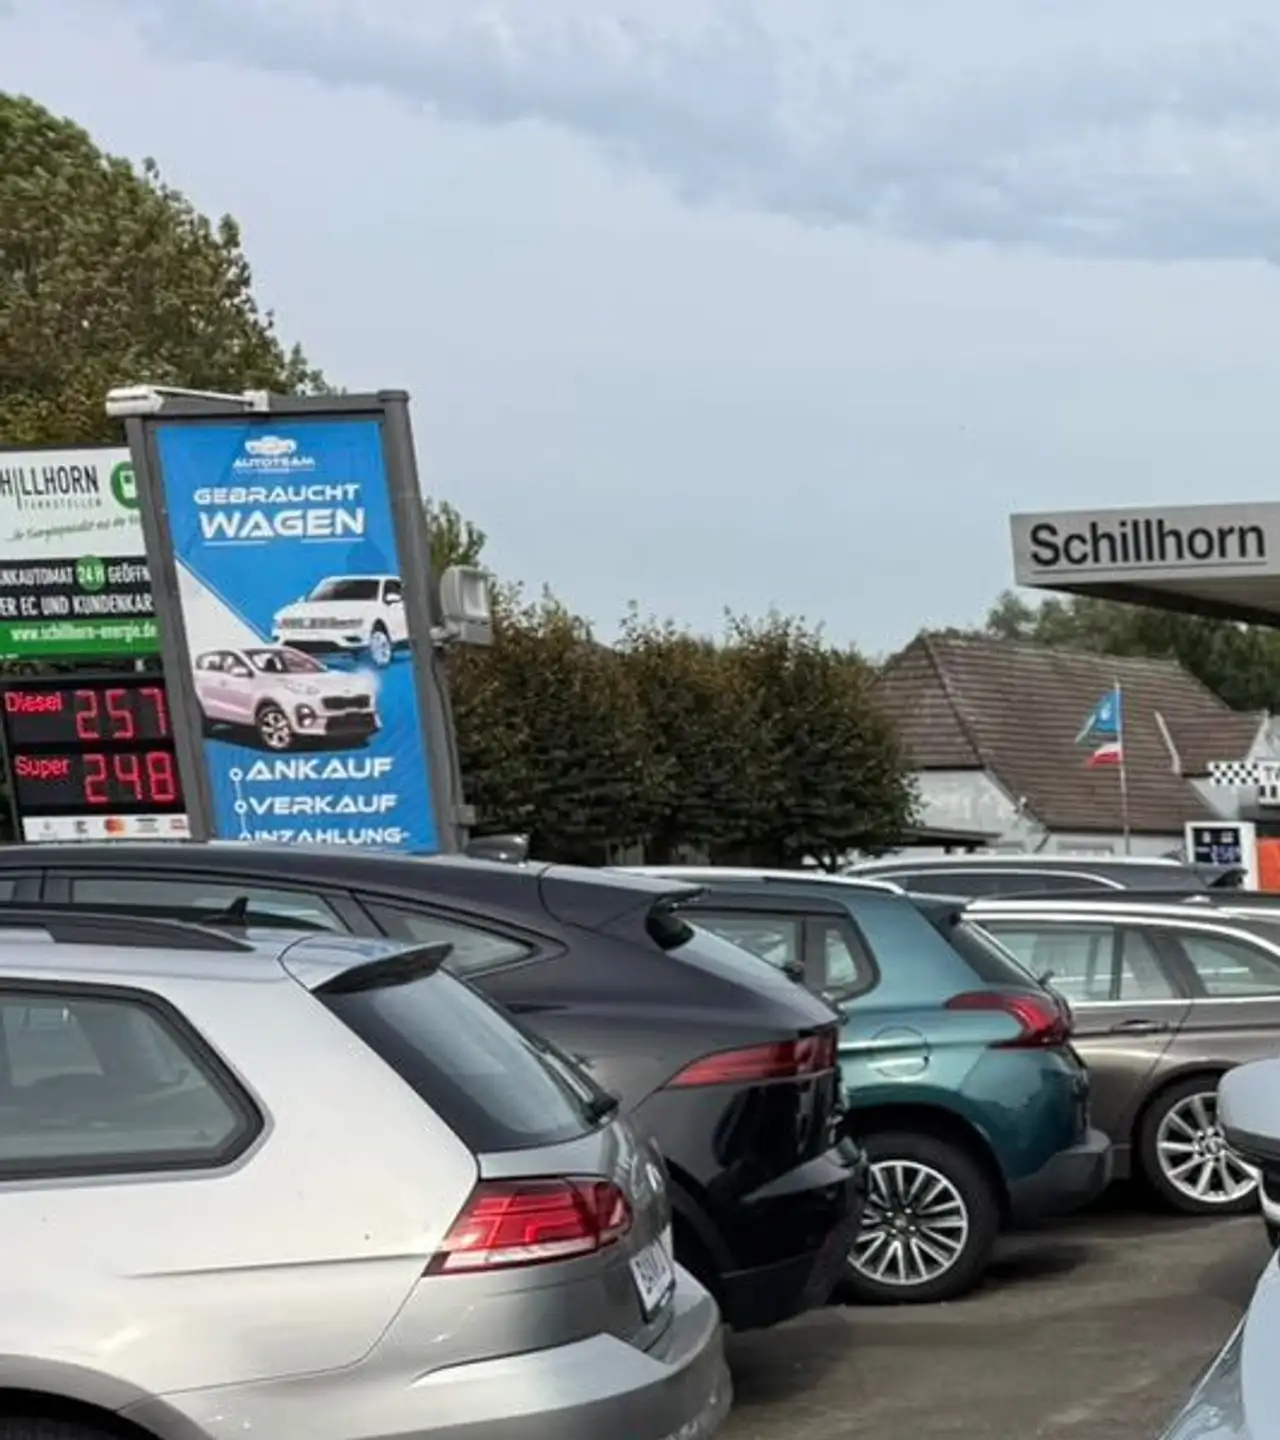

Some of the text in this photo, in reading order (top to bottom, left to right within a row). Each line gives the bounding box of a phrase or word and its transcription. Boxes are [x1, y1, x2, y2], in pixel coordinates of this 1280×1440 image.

[232, 456, 315, 469] AUTOTEAM
[193, 482, 361, 505] GEBRAUCHT
[199, 507, 365, 539] WAGEN
[1029, 518, 1265, 567] Schillhorn
[20, 595, 38, 615] EC
[40, 595, 69, 615] UND
[5, 687, 167, 739] Diesel 257
[15, 751, 176, 804] Super 248
[245, 757, 394, 781] ANKAUF
[249, 794, 398, 815] VERKAUF
